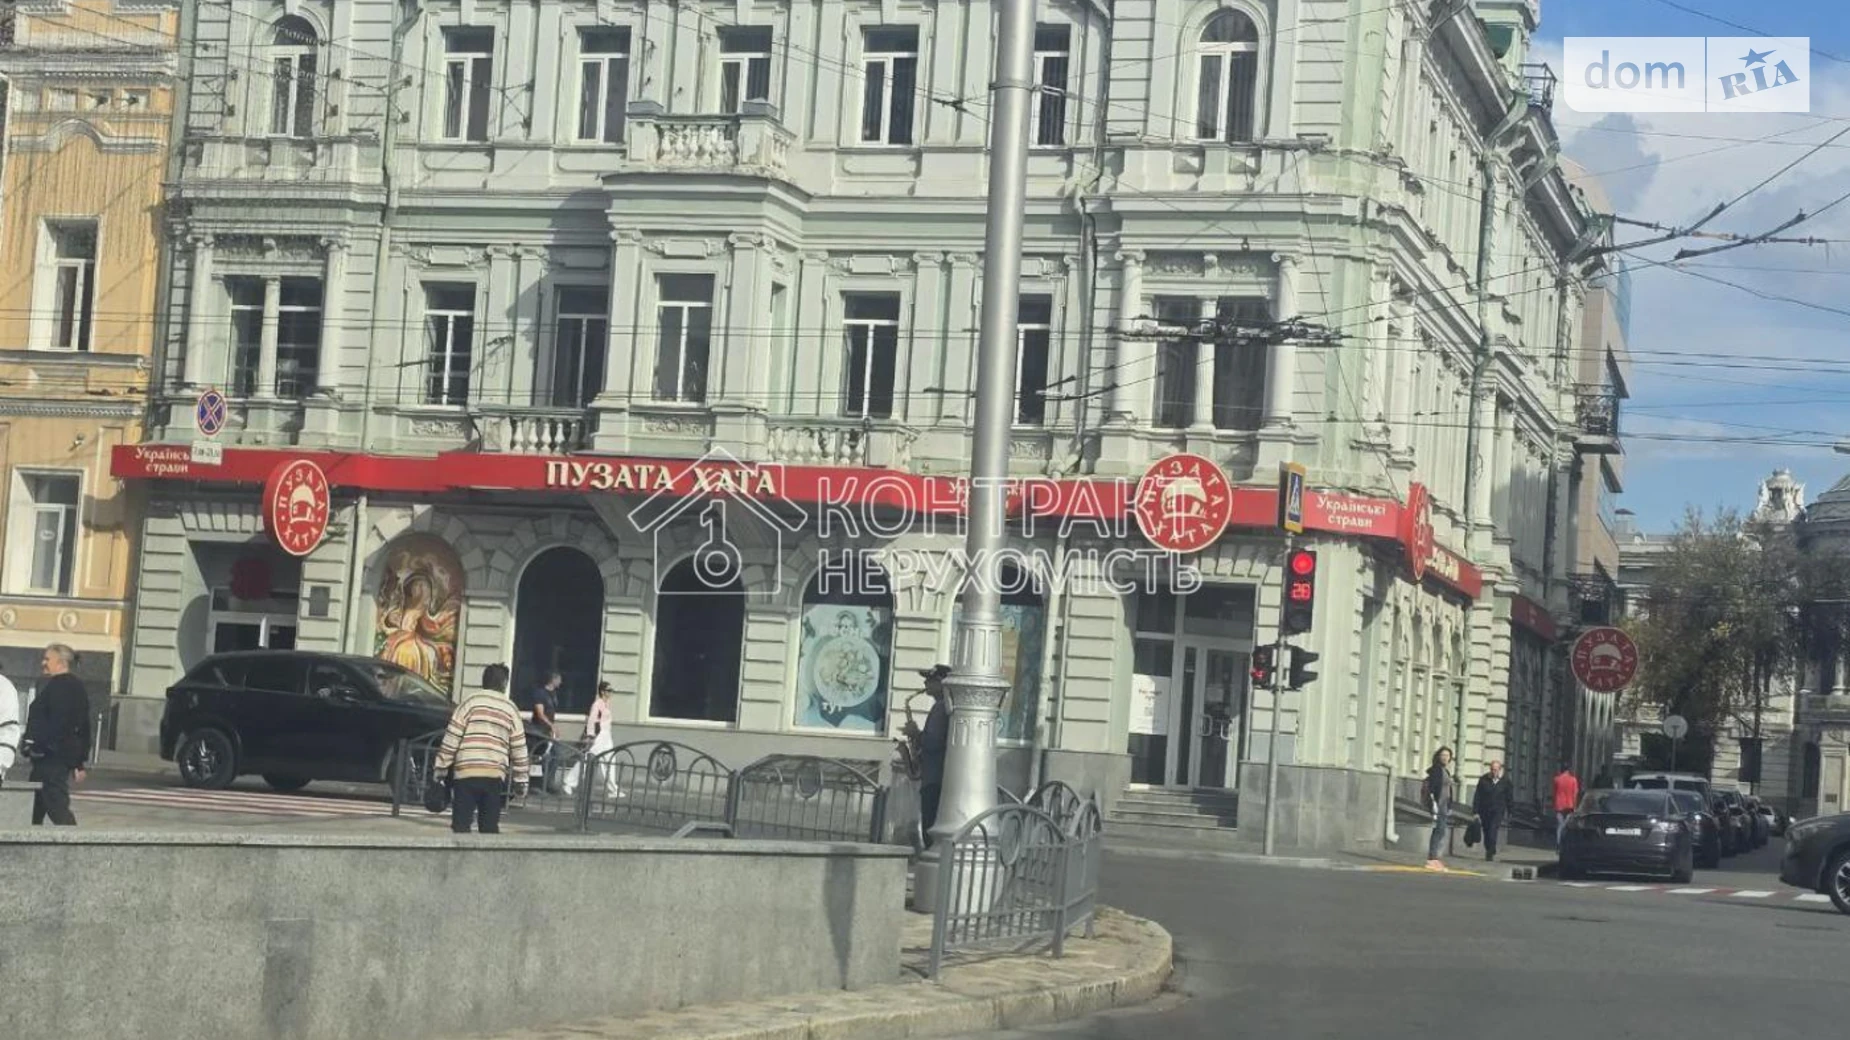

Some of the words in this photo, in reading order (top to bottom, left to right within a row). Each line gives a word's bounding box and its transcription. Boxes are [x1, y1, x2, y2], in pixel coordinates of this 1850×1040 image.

[146, 463, 188, 476] страви
[547, 460, 674, 490] ПУЗАТА
[692, 467, 776, 494] ХАТА
[278, 468, 326, 510] ПУЗАТА
[1316, 495, 1386, 516] Українські
[1327, 514, 1373, 529] страви
[283, 524, 320, 547] ХАТА
